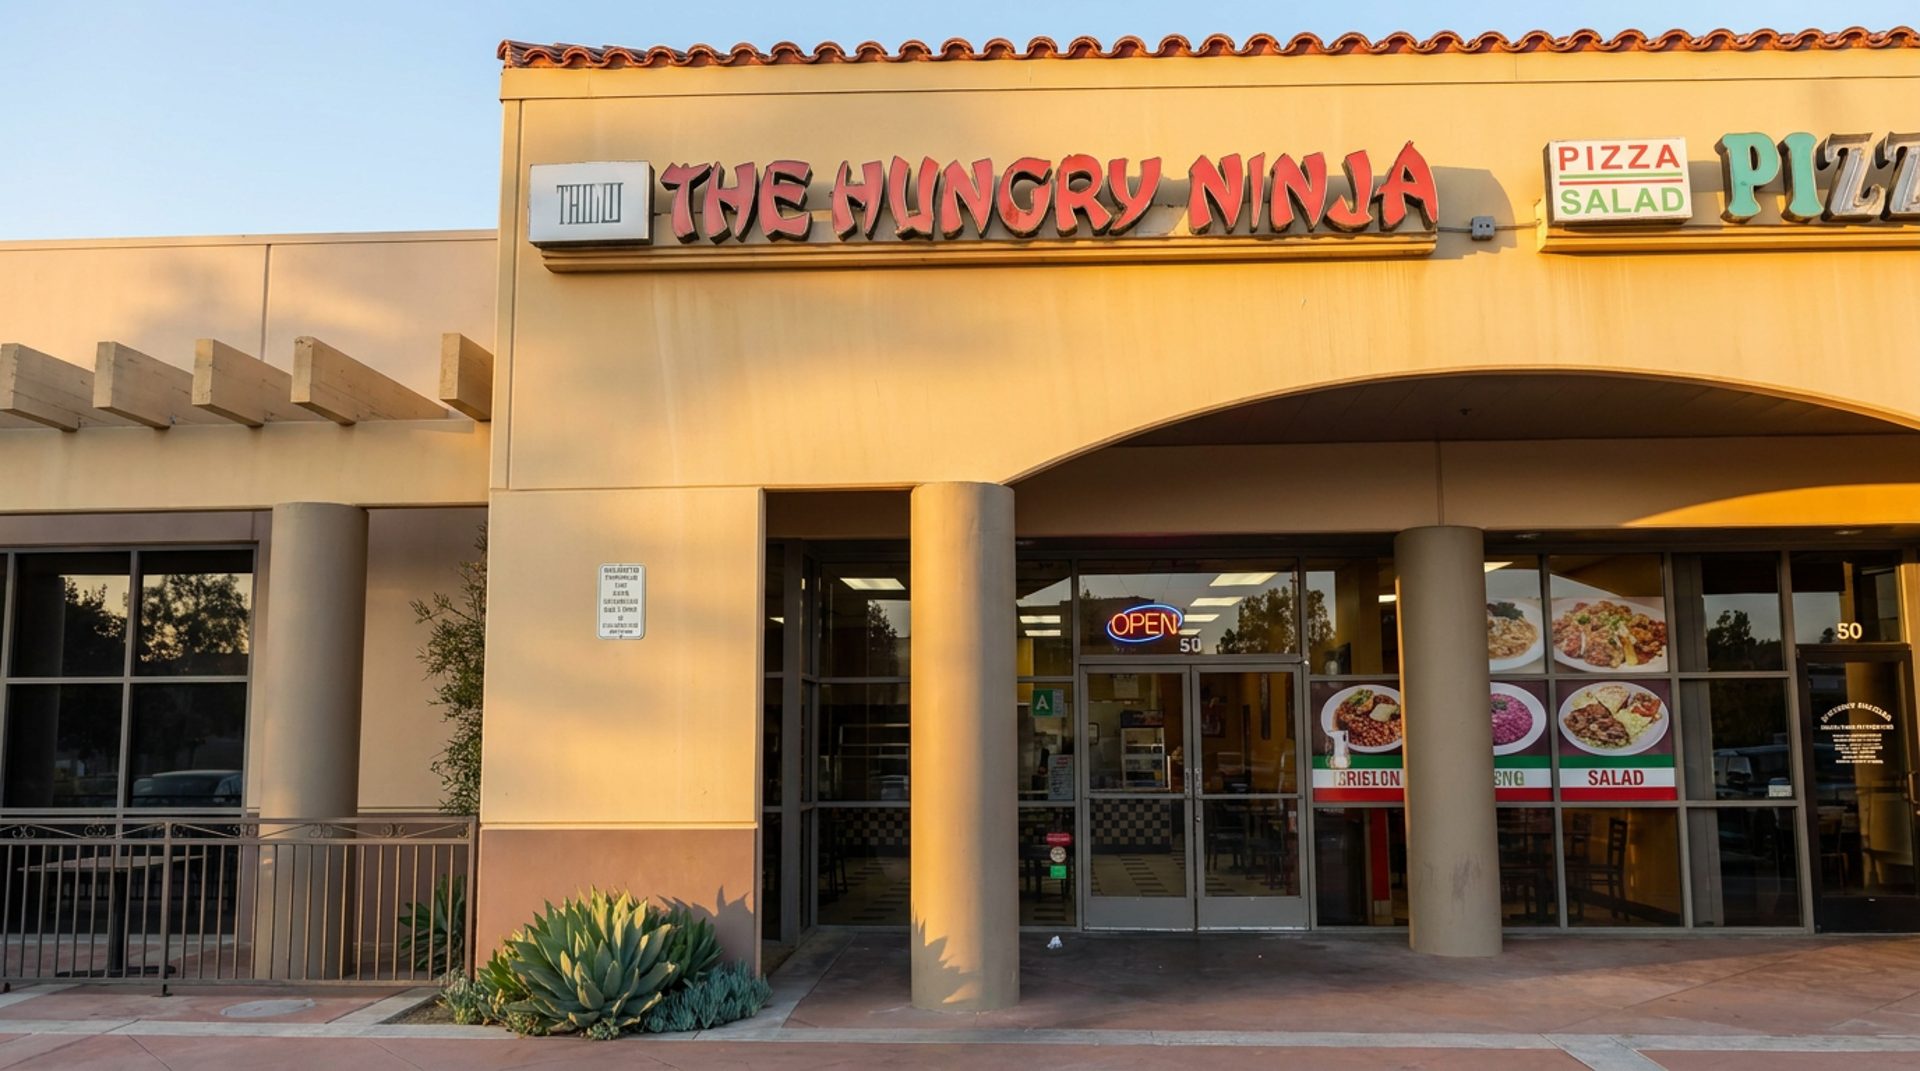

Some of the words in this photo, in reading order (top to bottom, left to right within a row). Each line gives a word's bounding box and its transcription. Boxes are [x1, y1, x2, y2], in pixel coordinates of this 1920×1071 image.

[1558, 143, 1681, 171] PIZZA
[661, 159, 814, 245] THE
[829, 153, 1162, 241] HUNGRY
[1187, 140, 1439, 234] NINJA
[1560, 186, 1685, 216] SALAD
[1110, 612, 1178, 636] OPEN
[1836, 622, 1863, 640] 50
[1180, 637, 1202, 653] 50
[1035, 694, 1049, 710] A
[1588, 769, 1645, 786] SALAD
